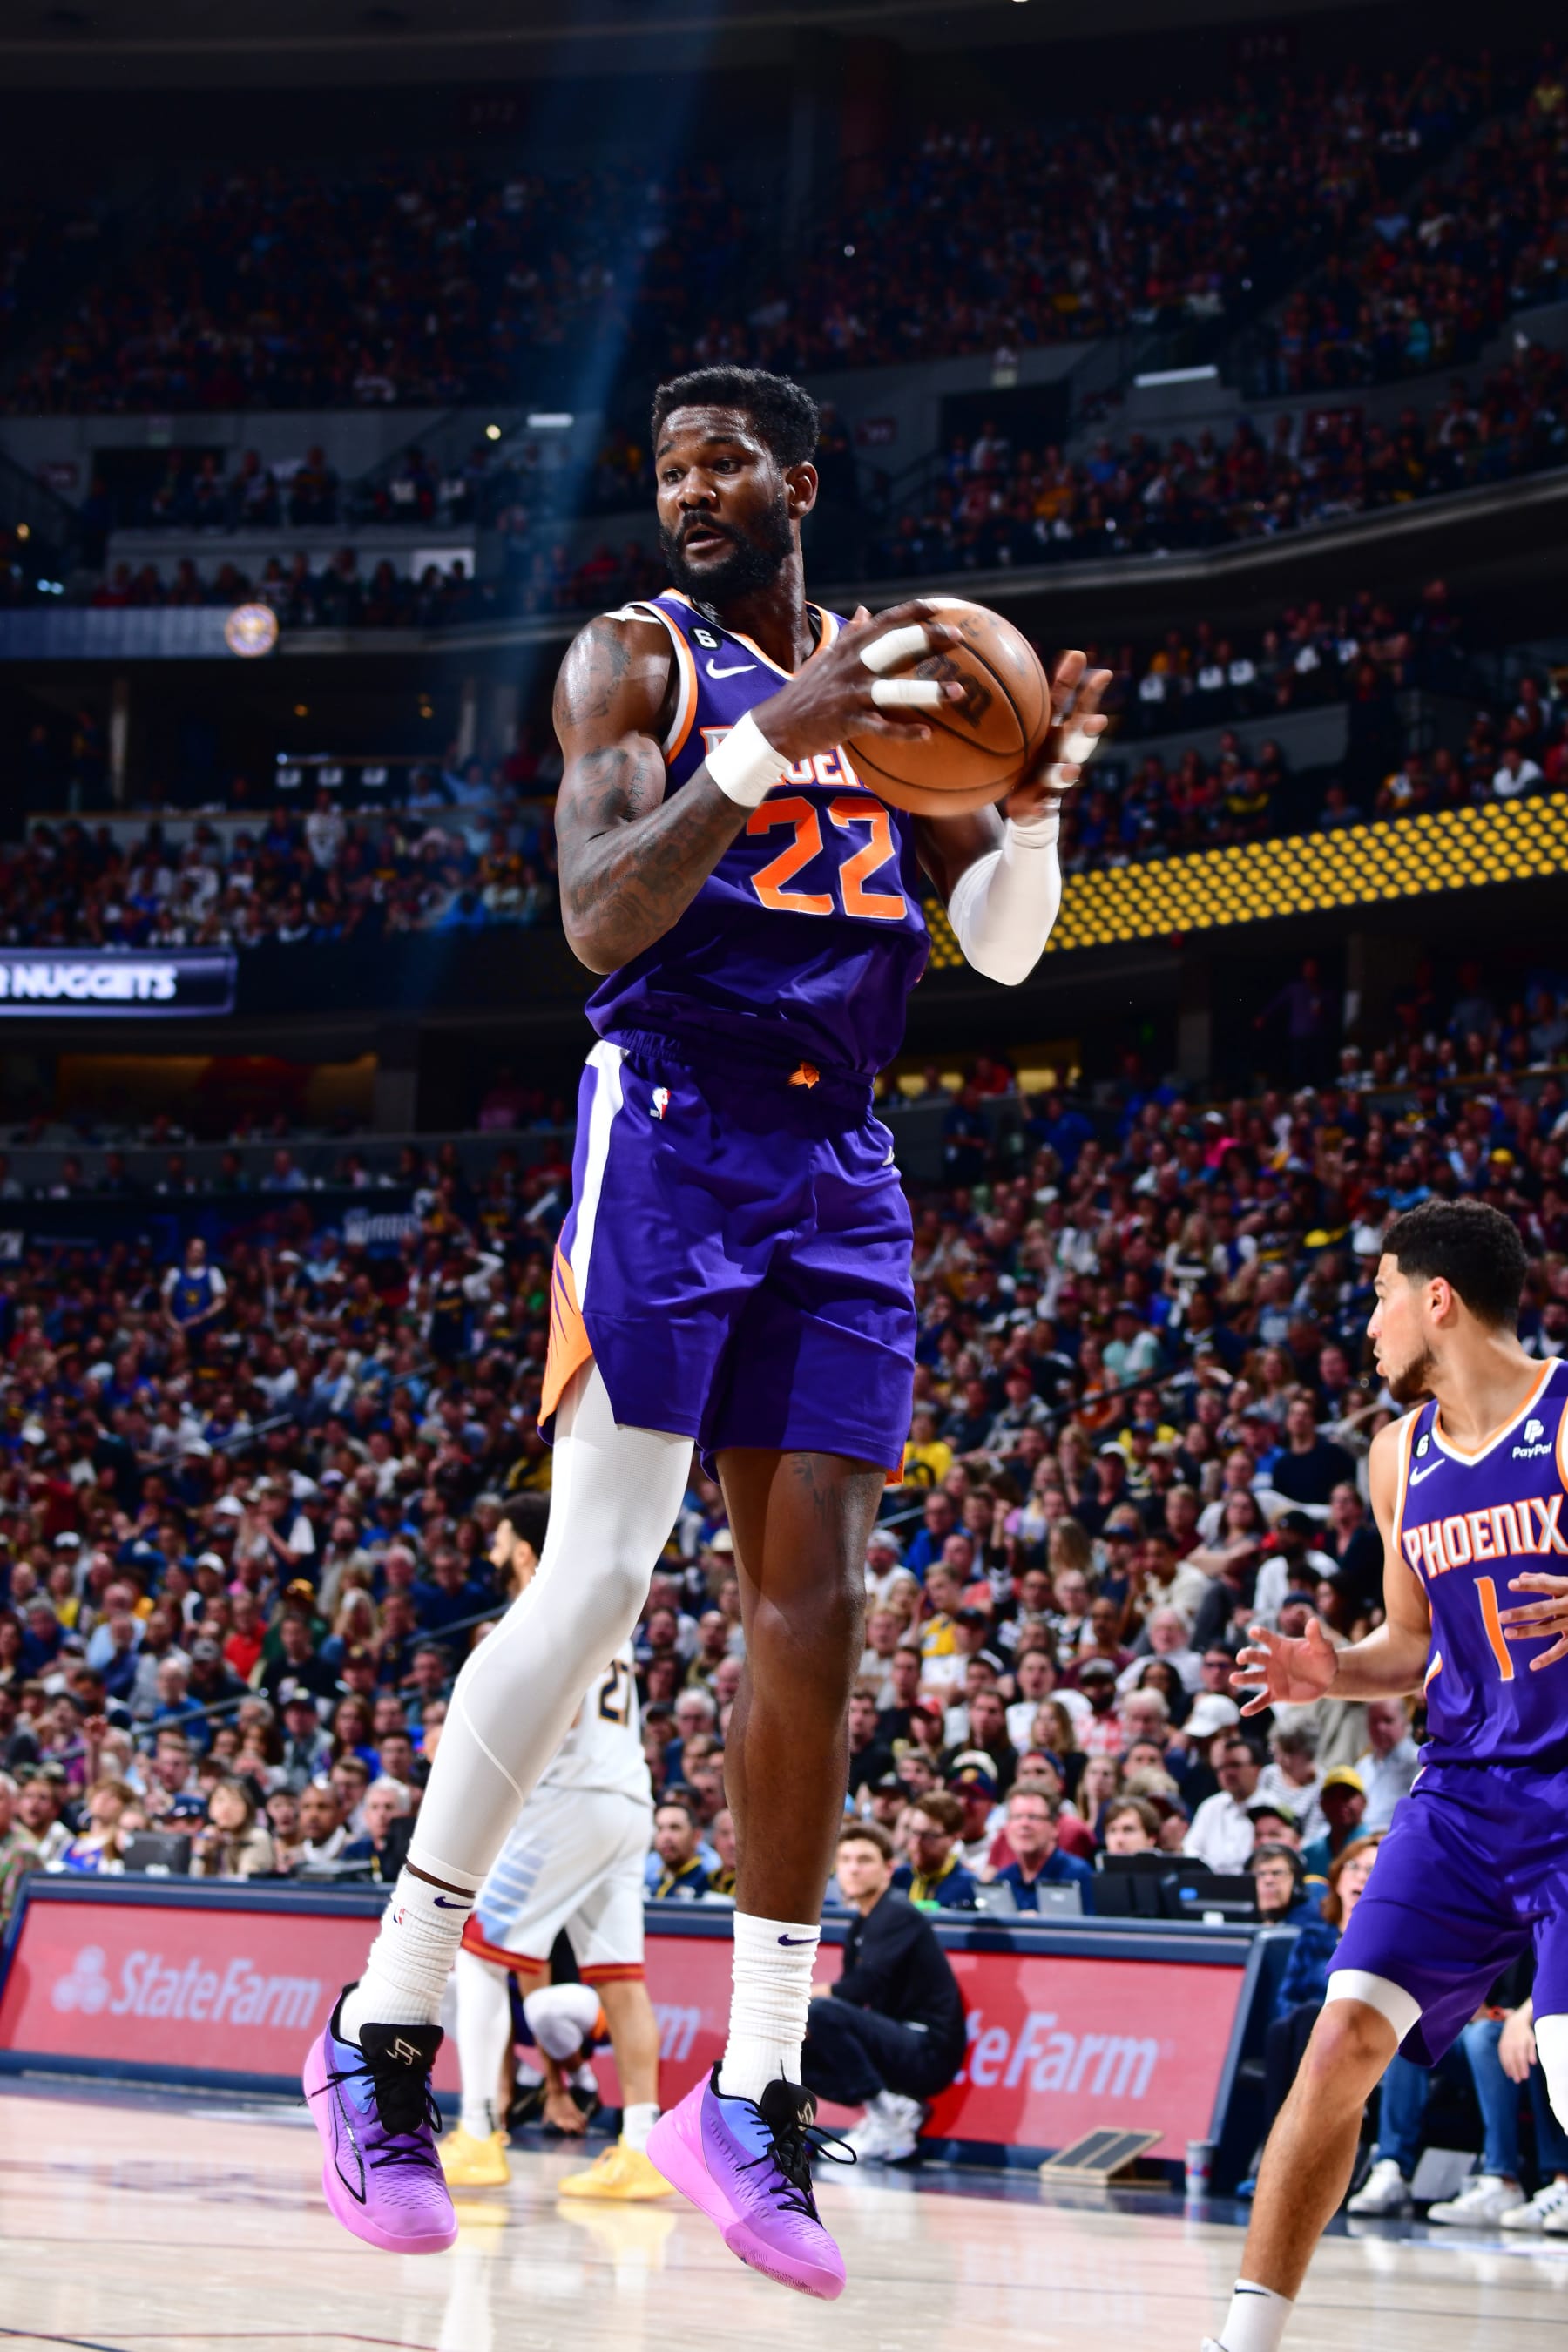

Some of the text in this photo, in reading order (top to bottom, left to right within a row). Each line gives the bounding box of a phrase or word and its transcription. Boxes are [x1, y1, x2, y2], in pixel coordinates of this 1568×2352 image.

[693, 628, 718, 648] 6
[747, 796, 907, 920] 22
[11, 963, 177, 999] NUGGETS
[1416, 1433, 1429, 1458] 6
[1511, 1442, 1552, 1459] PayPal
[1402, 1493, 1568, 1579] PHOENIX
[1473, 1575, 1515, 1682] 1
